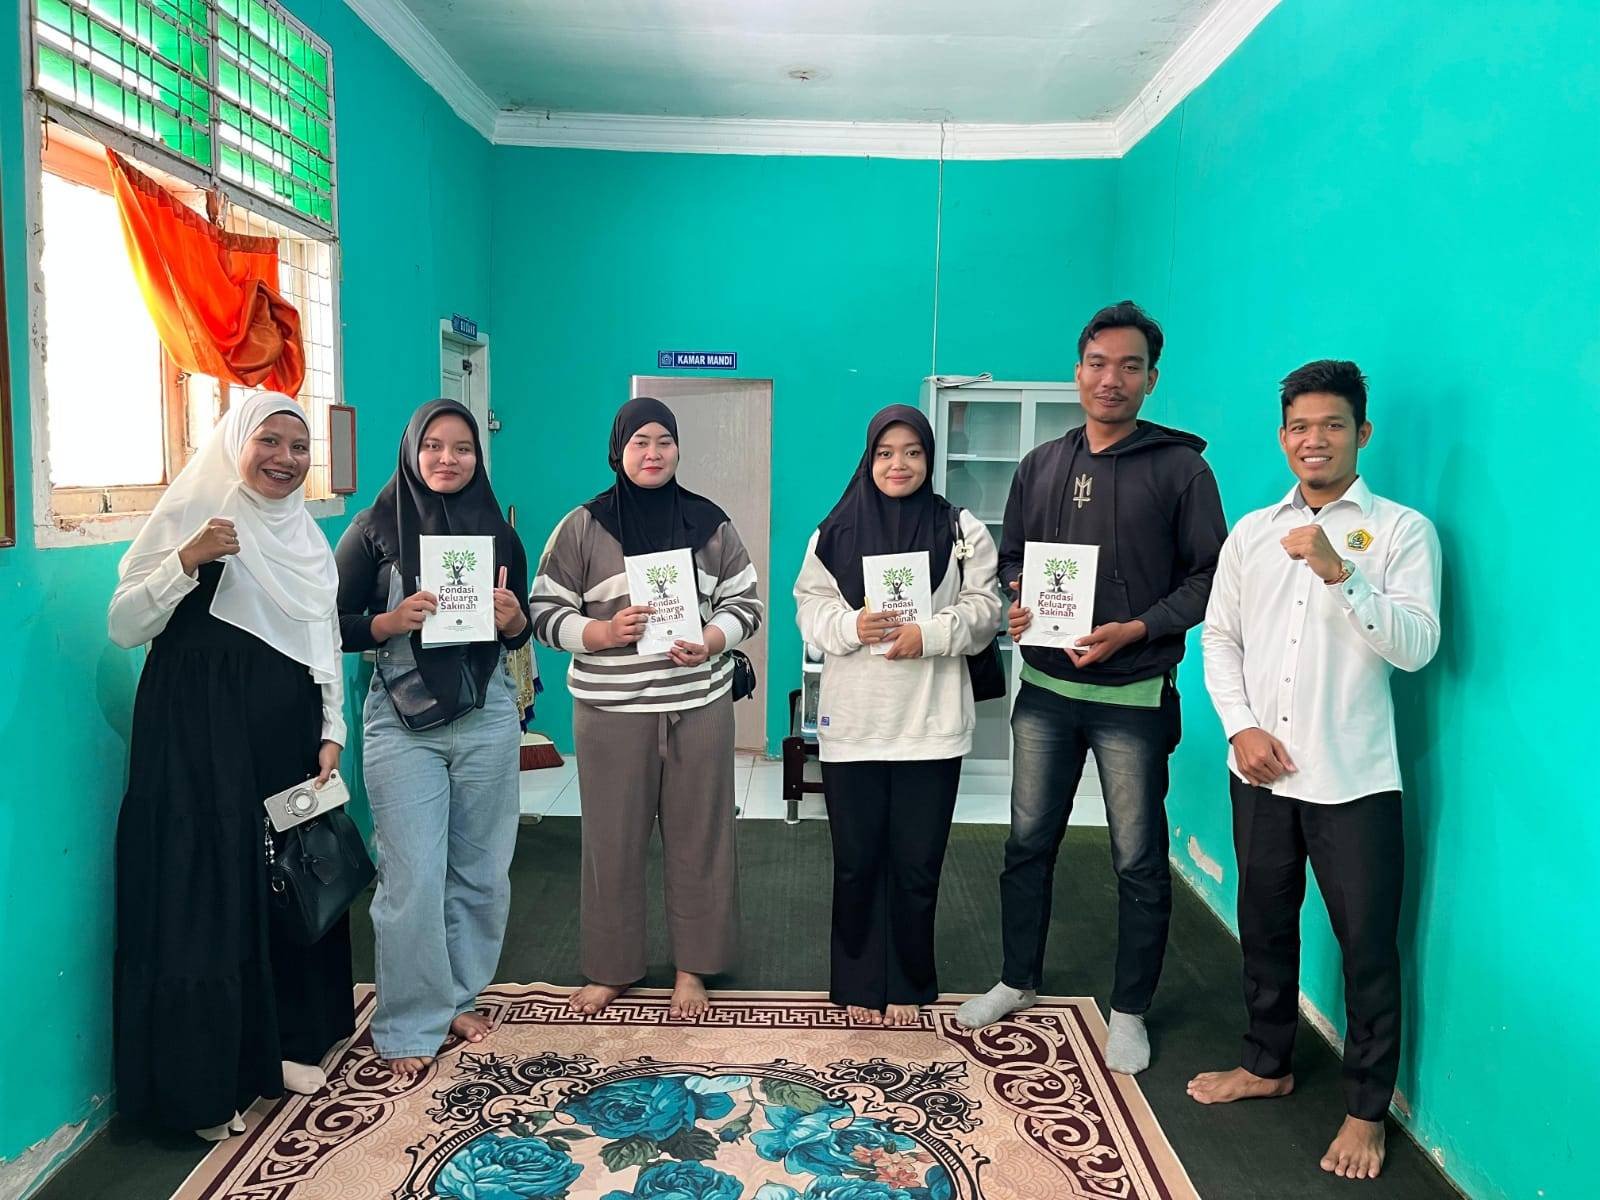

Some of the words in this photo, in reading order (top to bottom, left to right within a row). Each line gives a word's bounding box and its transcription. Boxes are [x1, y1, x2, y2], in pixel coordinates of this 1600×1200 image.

[677, 354, 706, 365] KAMAR
[707, 355, 732, 366] MANDI
[439, 585, 475, 594] Fondasi
[438, 594, 479, 604] Keluarga
[647, 596, 680, 608] Fondasi
[1039, 591, 1074, 602] Fondasi
[440, 602, 477, 610] Sakinah
[882, 599, 914, 609] Fondasi
[1037, 599, 1077, 612] Keluarga
[649, 605, 685, 616] eluarga
[1039, 607, 1074, 618] Sakinah
[650, 612, 684, 624] Sakinah
